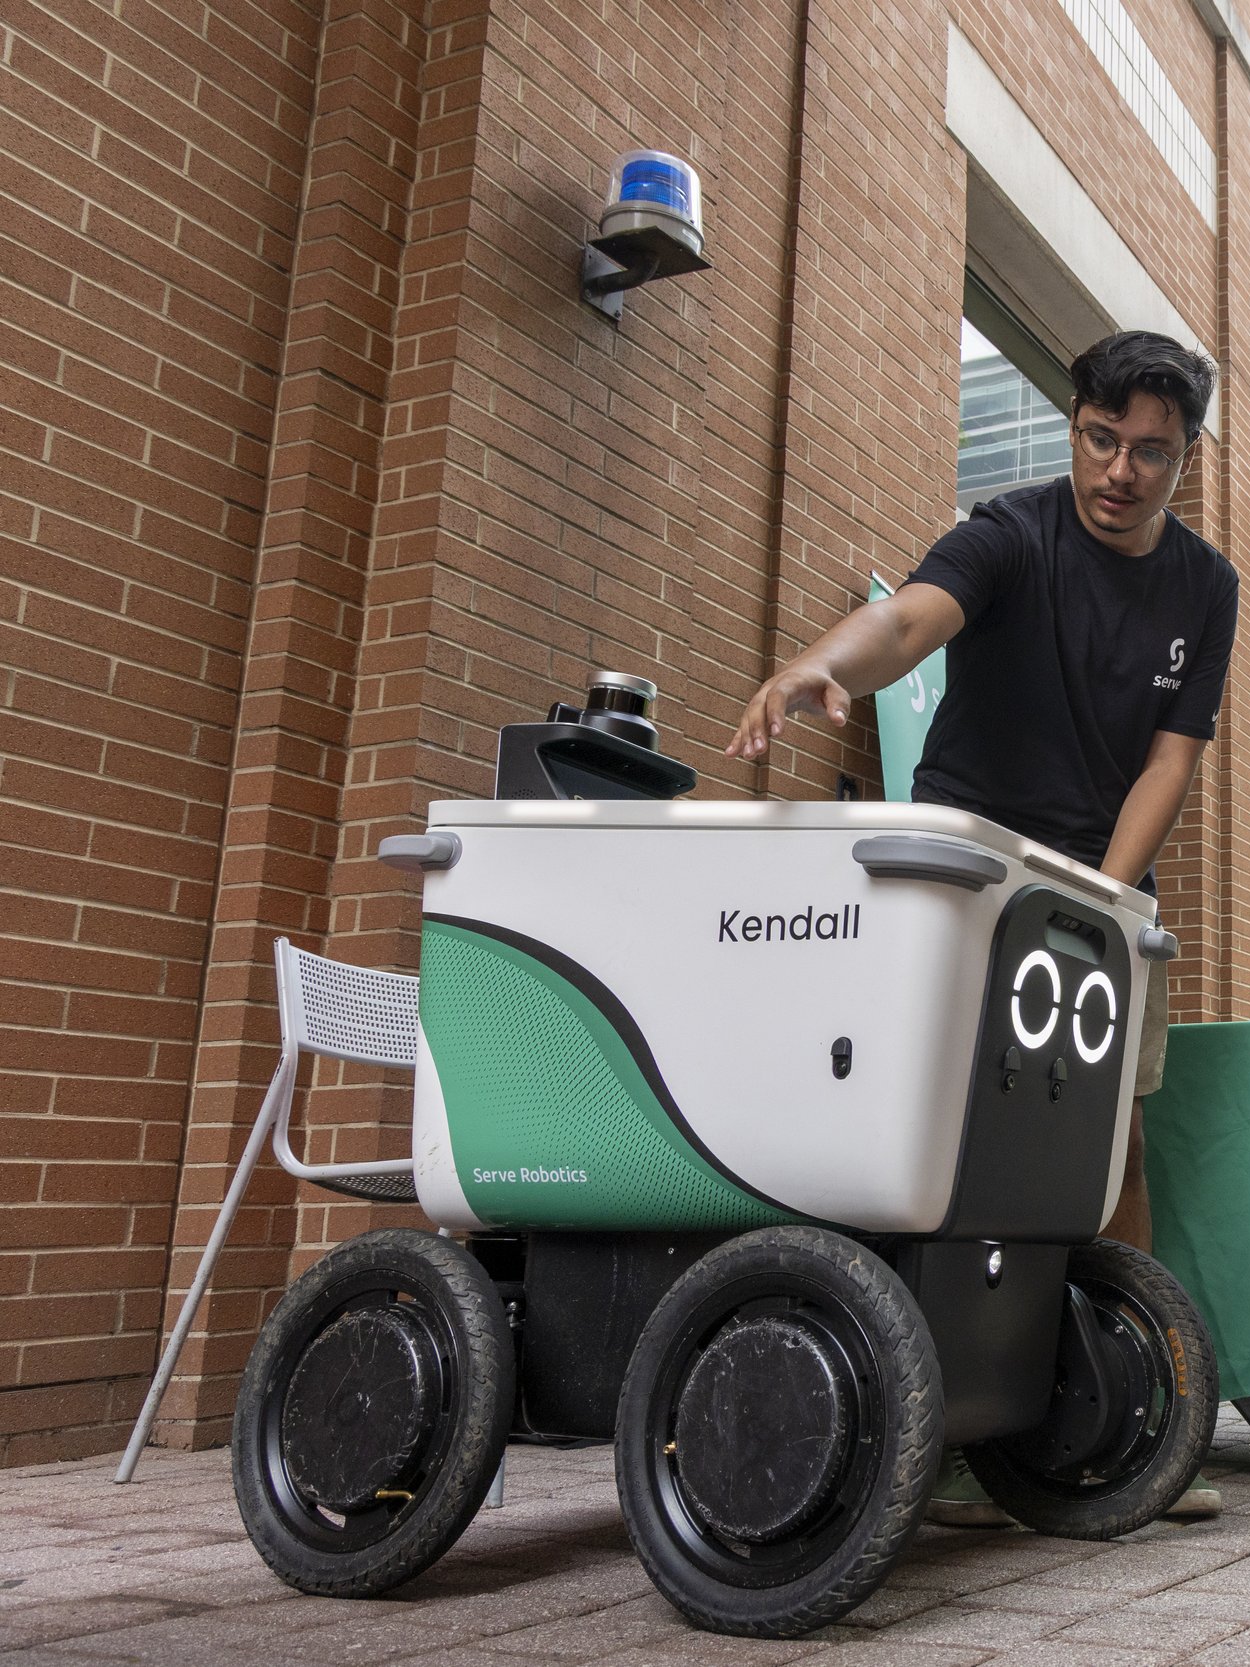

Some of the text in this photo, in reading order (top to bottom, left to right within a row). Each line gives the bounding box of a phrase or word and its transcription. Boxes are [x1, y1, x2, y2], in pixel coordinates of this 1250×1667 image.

[1153, 675, 1181, 690] serve
[718, 904, 860, 943] Kendall
[473, 1165, 587, 1184] Serve Robotics
